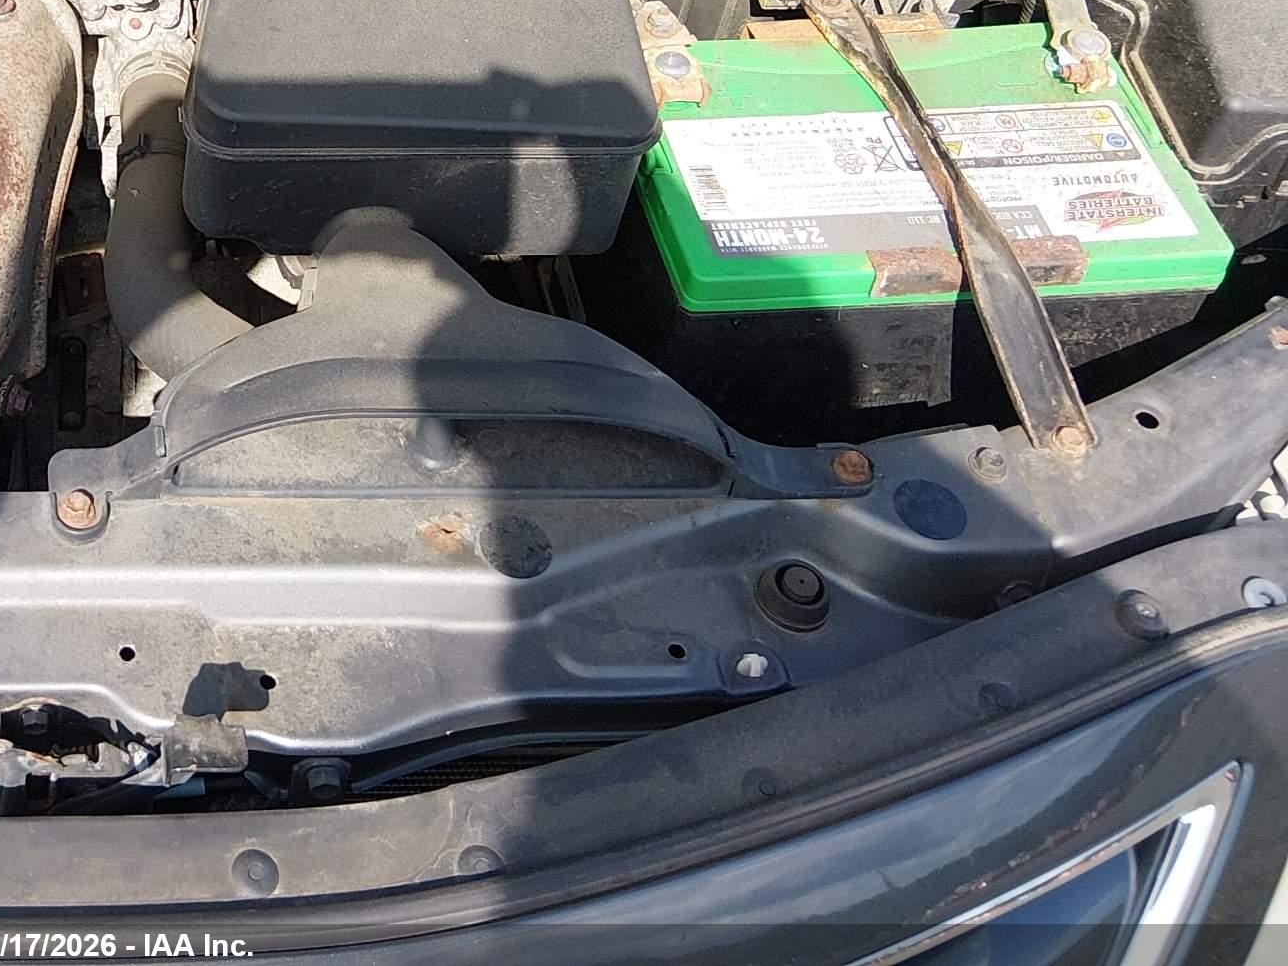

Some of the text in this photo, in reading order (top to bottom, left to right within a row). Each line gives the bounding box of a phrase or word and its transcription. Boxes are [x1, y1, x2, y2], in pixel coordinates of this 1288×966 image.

[1002, 154, 1105, 165] DANGER/POISON
[1052, 173, 1139, 187] AUTOMOTIVE
[1067, 196, 1154, 210] BATTERIES
[1067, 206, 1163, 221] INTERSTATE
[711, 218, 817, 231] FREE REPLACEMENT
[907, 215, 941, 226] RC 110
[712, 226, 825, 248] 24-MONTH
[740, 244, 777, 253] WARRANTY
